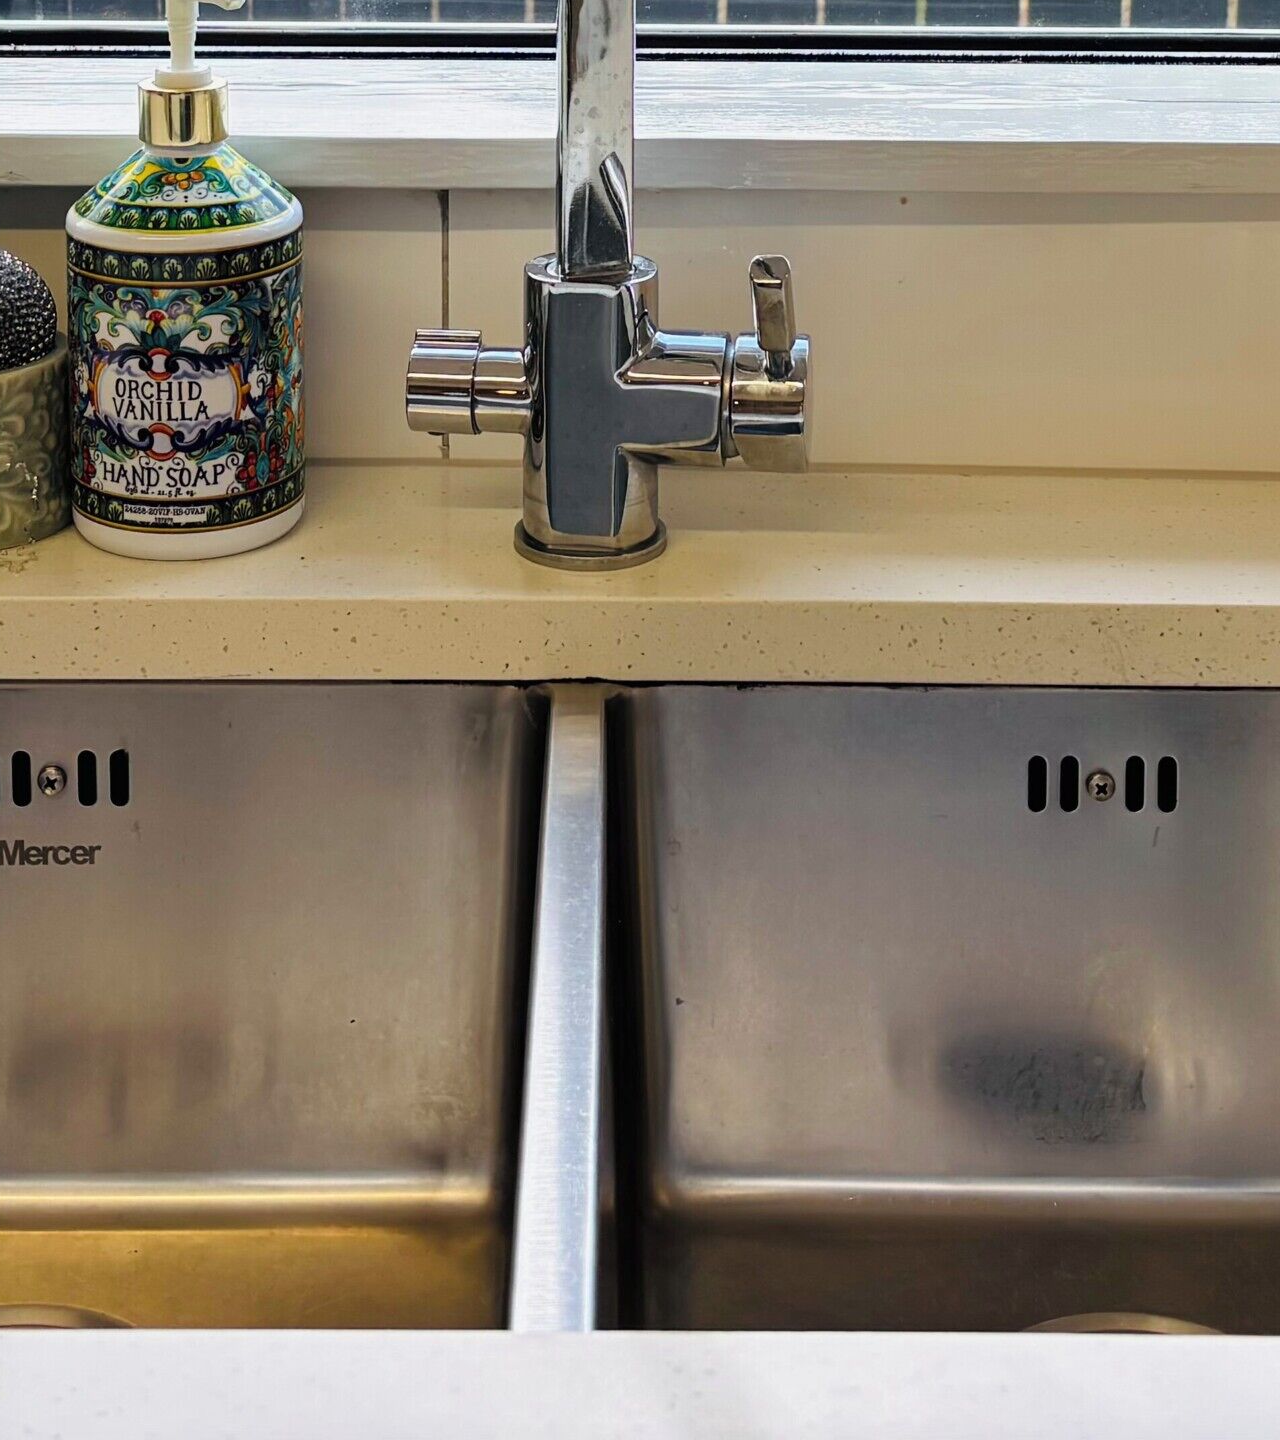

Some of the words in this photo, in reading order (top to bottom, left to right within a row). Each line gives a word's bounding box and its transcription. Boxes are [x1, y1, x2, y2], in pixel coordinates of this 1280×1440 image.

[115, 378, 202, 401] ORCHID
[112, 397, 210, 421] VANILLA
[103, 461, 160, 487] HAND
[166, 464, 225, 488] SOAP
